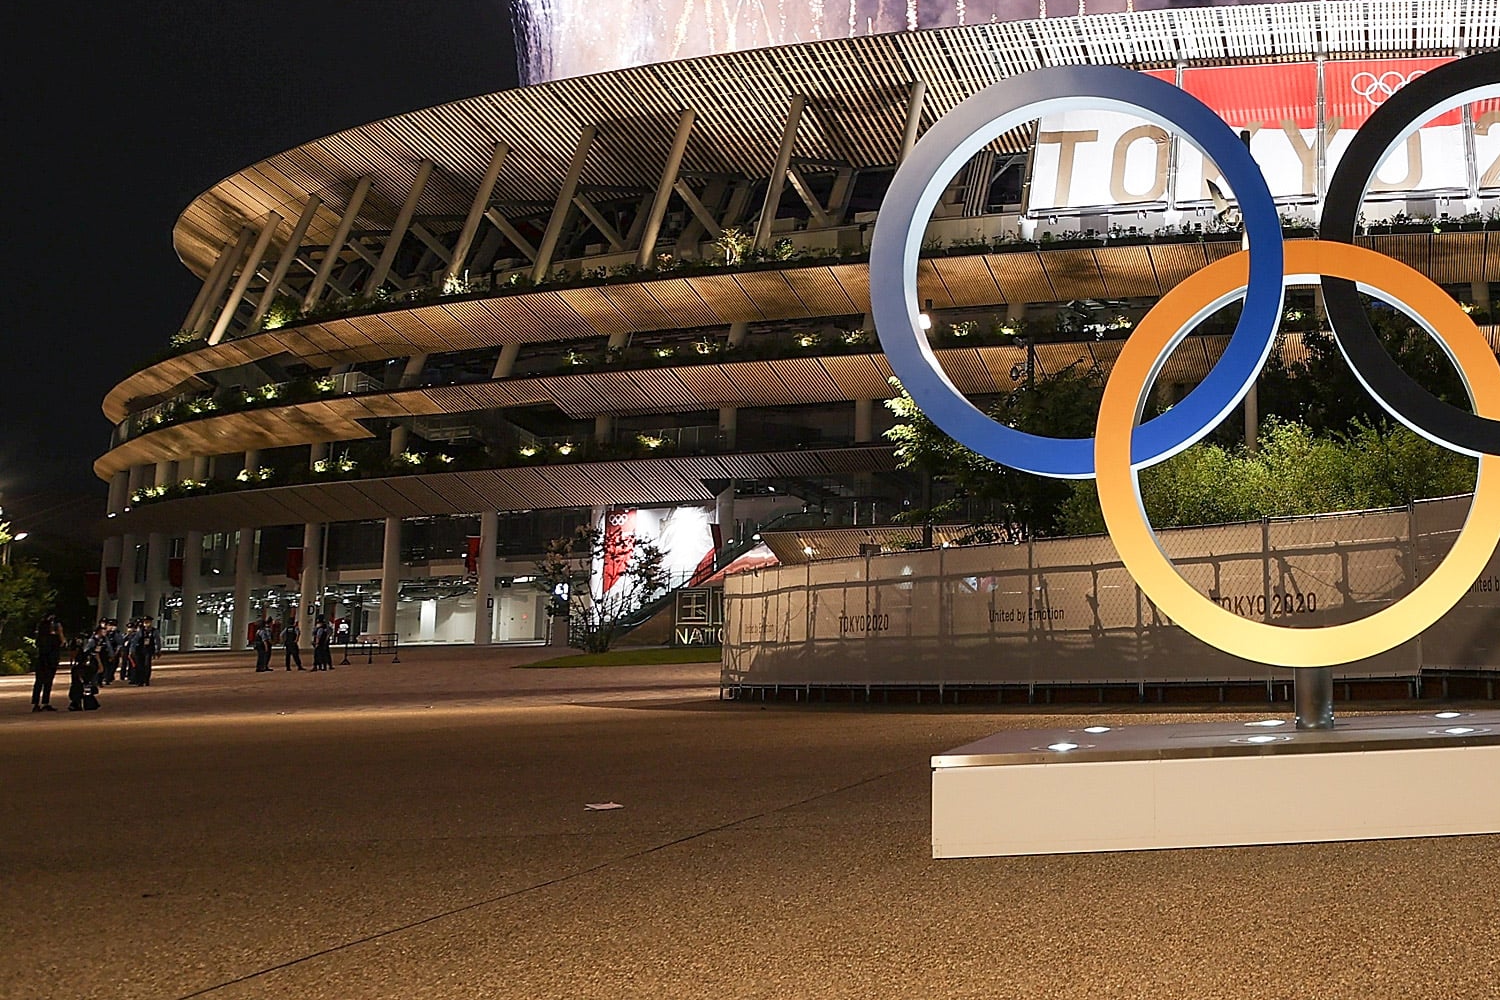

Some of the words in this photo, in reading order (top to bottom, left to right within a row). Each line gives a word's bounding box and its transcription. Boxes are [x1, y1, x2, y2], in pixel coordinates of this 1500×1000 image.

[1468, 576, 1492, 592] nited
[1272, 592, 1317, 615] 2020
[839, 615, 865, 633] TOKYO
[866, 614, 889, 632] 2020
[989, 609, 1014, 623] United
[1017, 608, 1026, 623] by
[1028, 608, 1064, 622] Emotion
